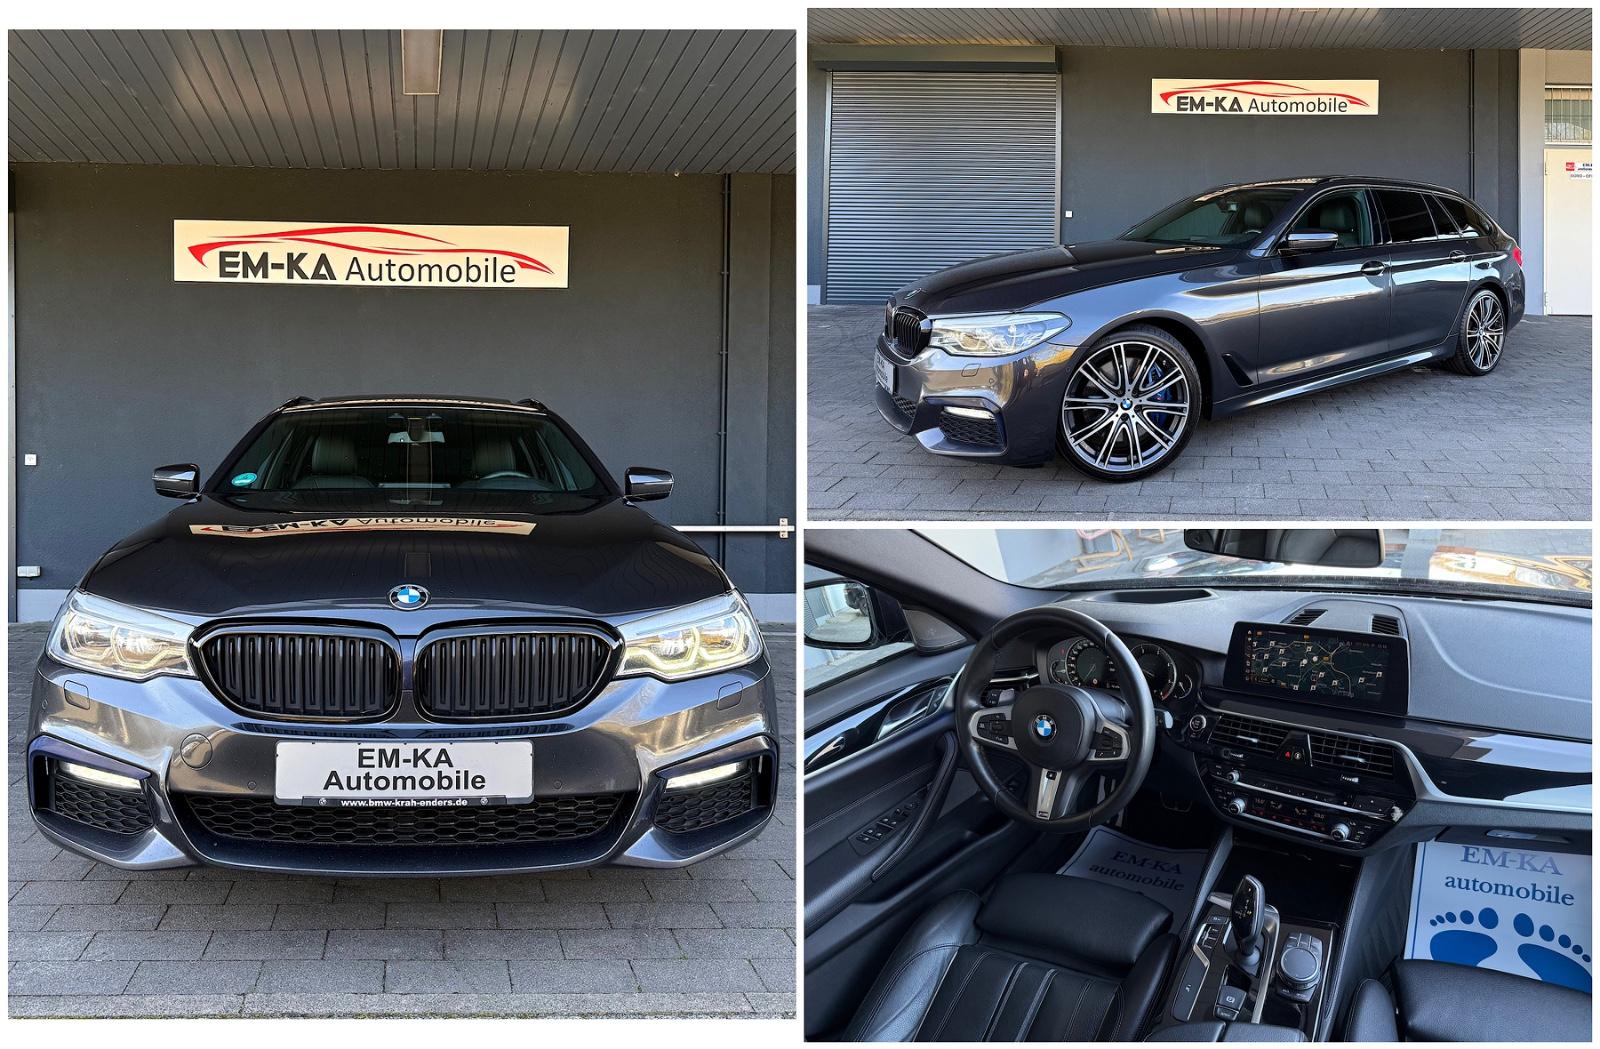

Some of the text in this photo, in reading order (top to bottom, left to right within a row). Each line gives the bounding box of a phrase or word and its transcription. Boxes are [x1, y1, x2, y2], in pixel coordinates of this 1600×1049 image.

[1176, 96, 1348, 113] EM-KA Automobile
[218, 250, 516, 283] EM-KA Automobile
[357, 748, 454, 768] EM-KA
[323, 769, 487, 791] Automobile
[340, 798, 468, 807] www.bmw-krah-enders.de
[1111, 850, 1182, 874] EM-KA
[1460, 845, 1563, 876] EM-KA
[1089, 864, 1185, 891] automobile
[1444, 875, 1575, 906] automobile
